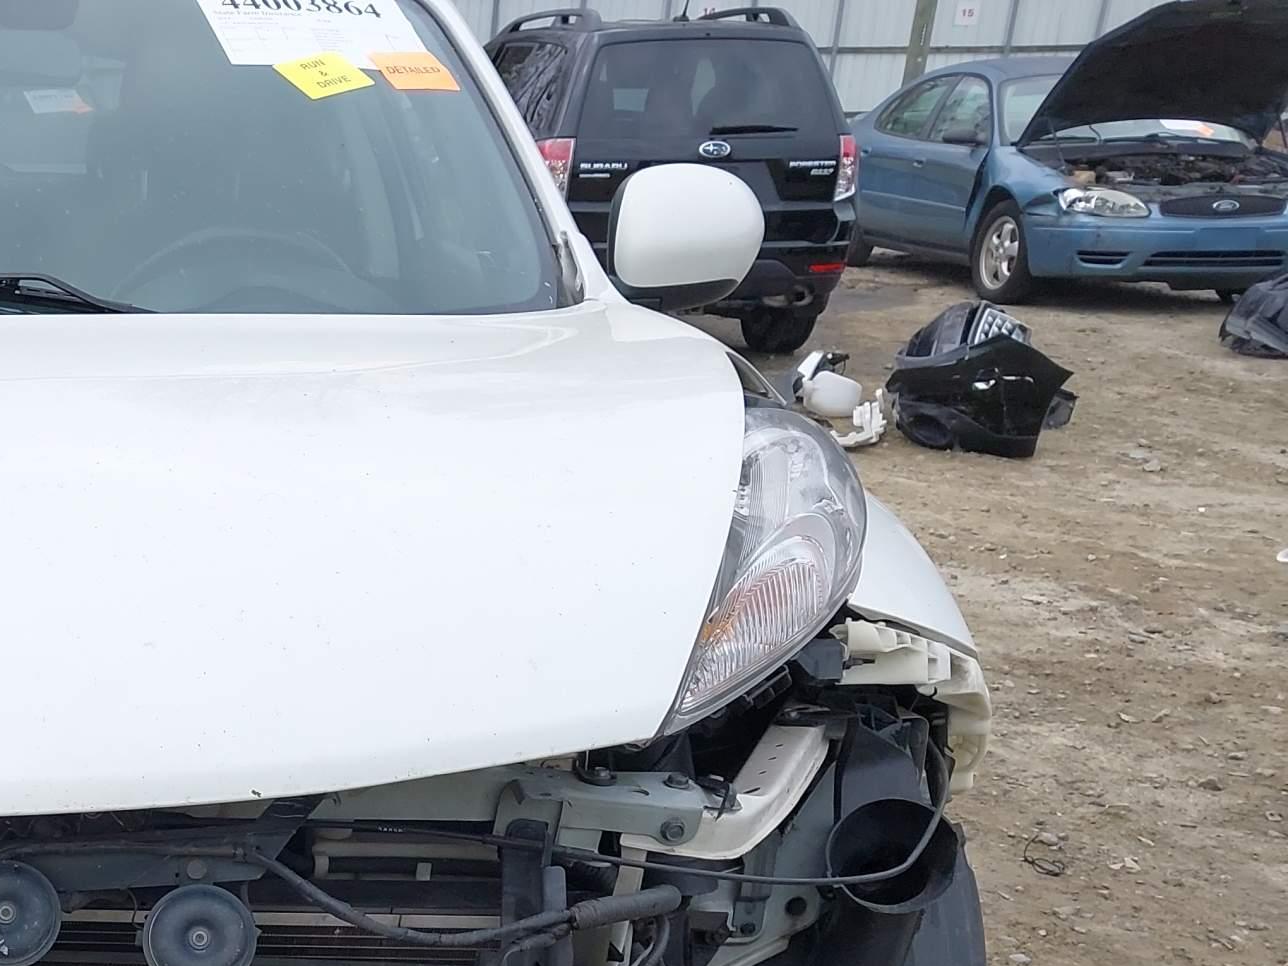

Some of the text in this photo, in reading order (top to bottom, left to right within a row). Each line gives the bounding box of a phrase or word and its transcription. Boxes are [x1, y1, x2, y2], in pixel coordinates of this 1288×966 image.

[961, 8, 975, 17] 15
[300, 58, 326, 71] RUN
[385, 65, 441, 75] DETAILED
[316, 75, 352, 89] DRIVE
